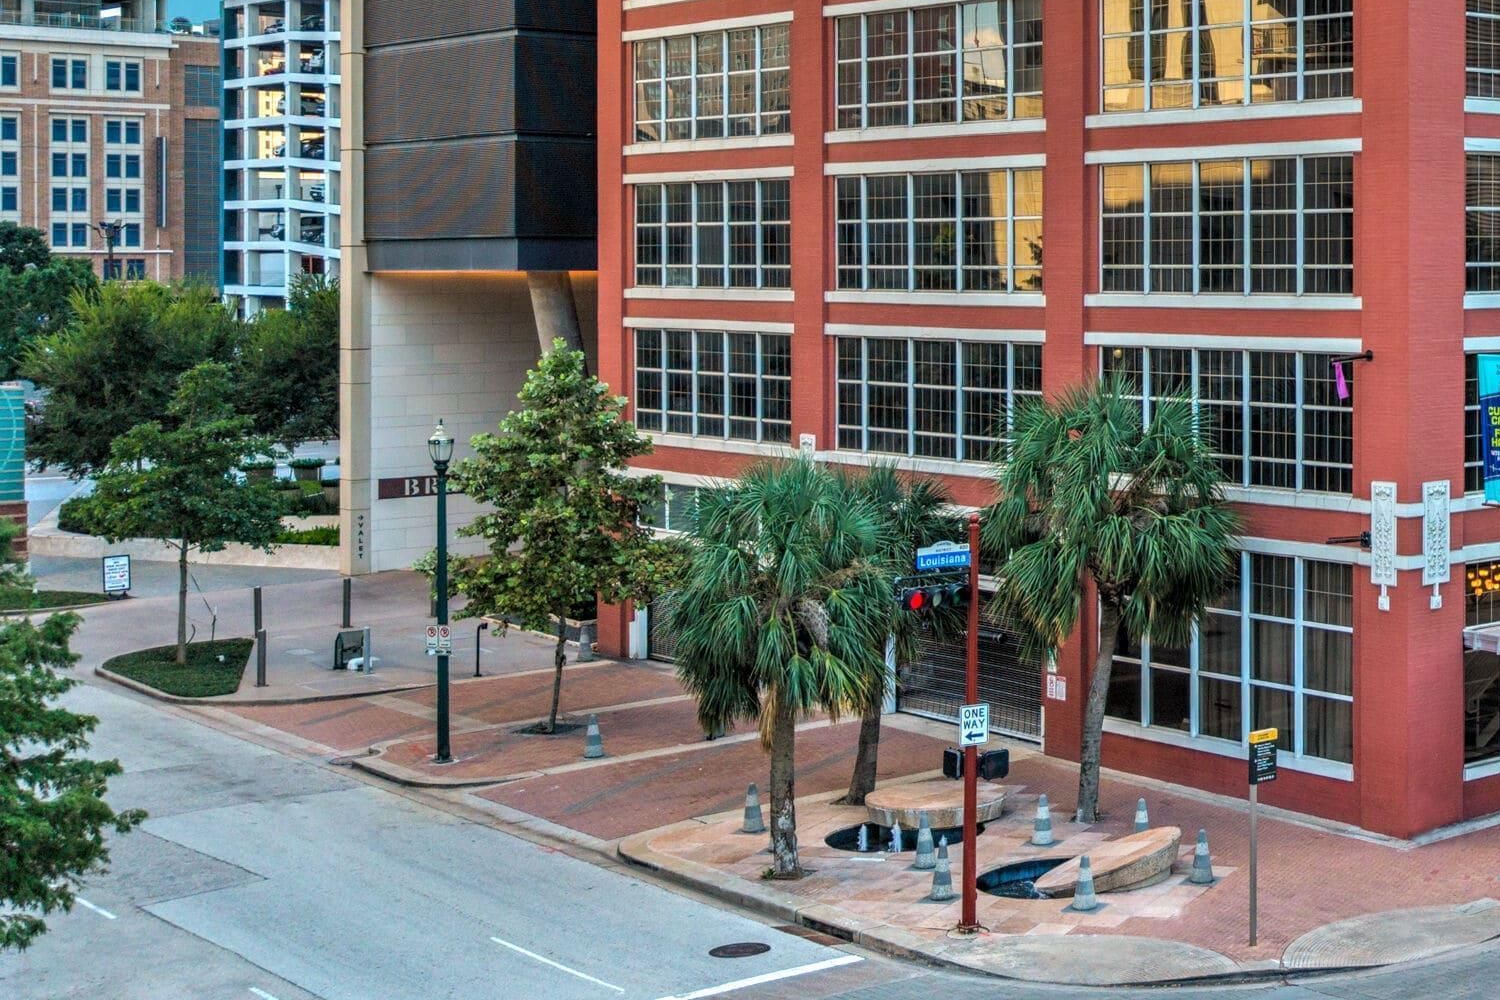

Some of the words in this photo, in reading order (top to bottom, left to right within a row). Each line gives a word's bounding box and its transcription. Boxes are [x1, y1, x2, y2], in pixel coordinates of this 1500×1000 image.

[920, 554, 966, 567] Louisiana
[964, 707, 985, 719] ONE
[964, 718, 986, 730] WAY
